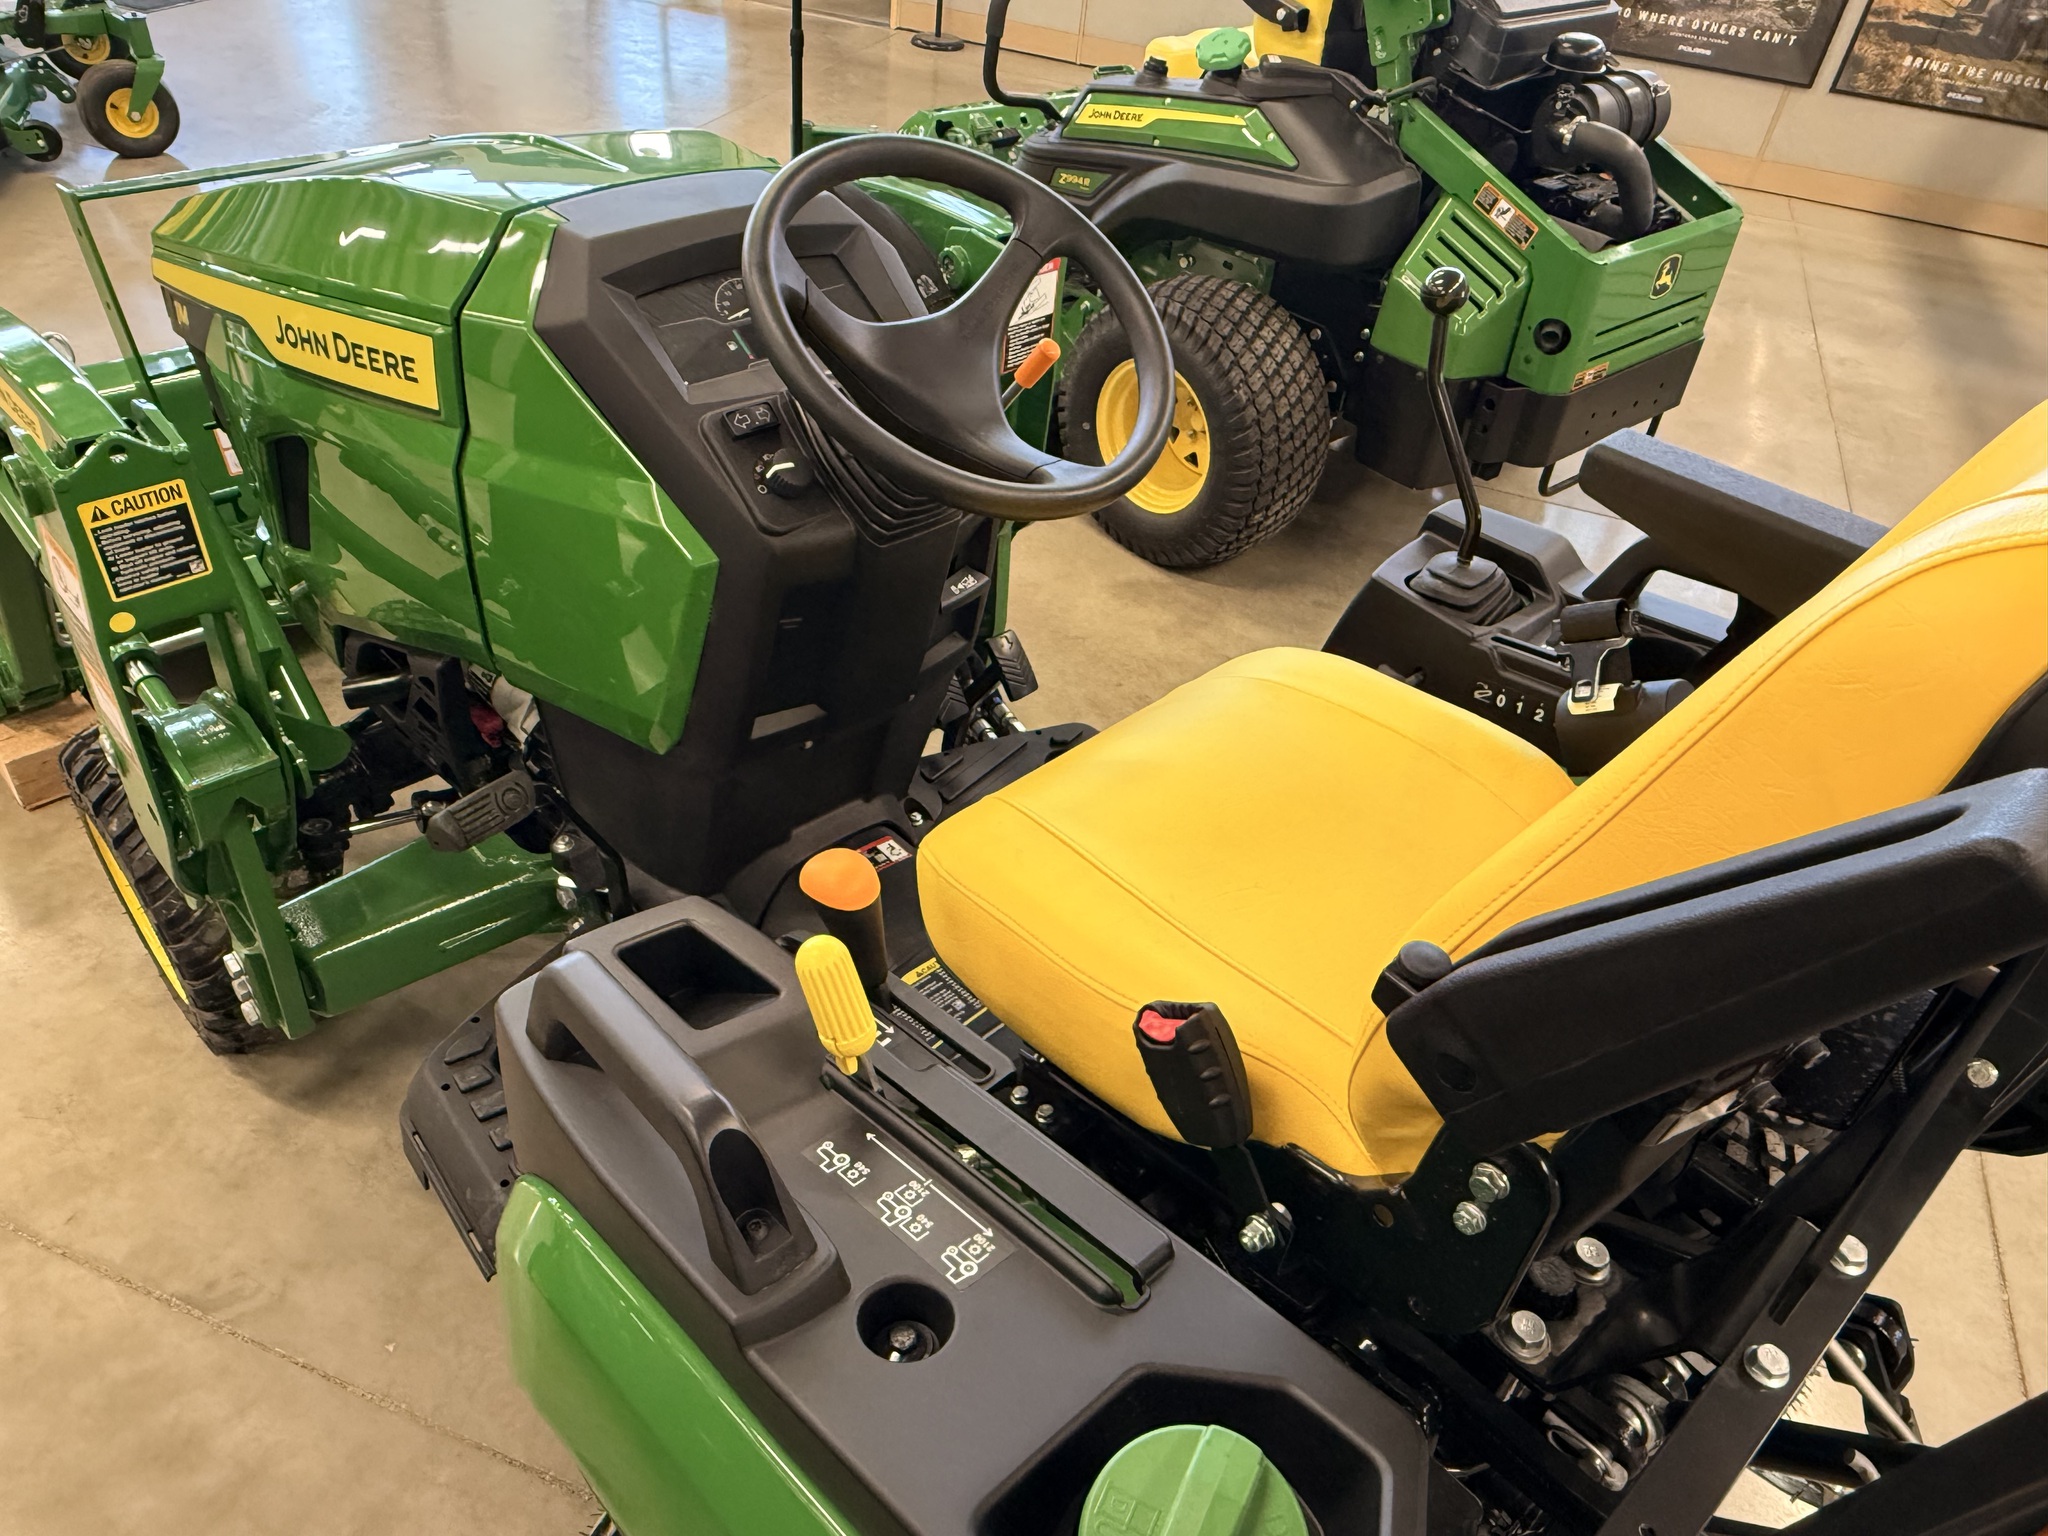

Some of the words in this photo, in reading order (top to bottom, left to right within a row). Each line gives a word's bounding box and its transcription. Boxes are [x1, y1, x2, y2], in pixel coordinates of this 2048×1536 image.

[1638, 10, 1684, 27] WHERE
[1691, 19, 1746, 38] OTHERS
[1752, 29, 1797, 46] CAN'T
[1957, 64, 1986, 78] THE
[1088, 109, 1112, 120] JOHN
[1113, 110, 1144, 122] DEERE
[276, 315, 331, 359] JOHN
[331, 331, 419, 384] DEERE
[110, 483, 183, 516] CAUTION
